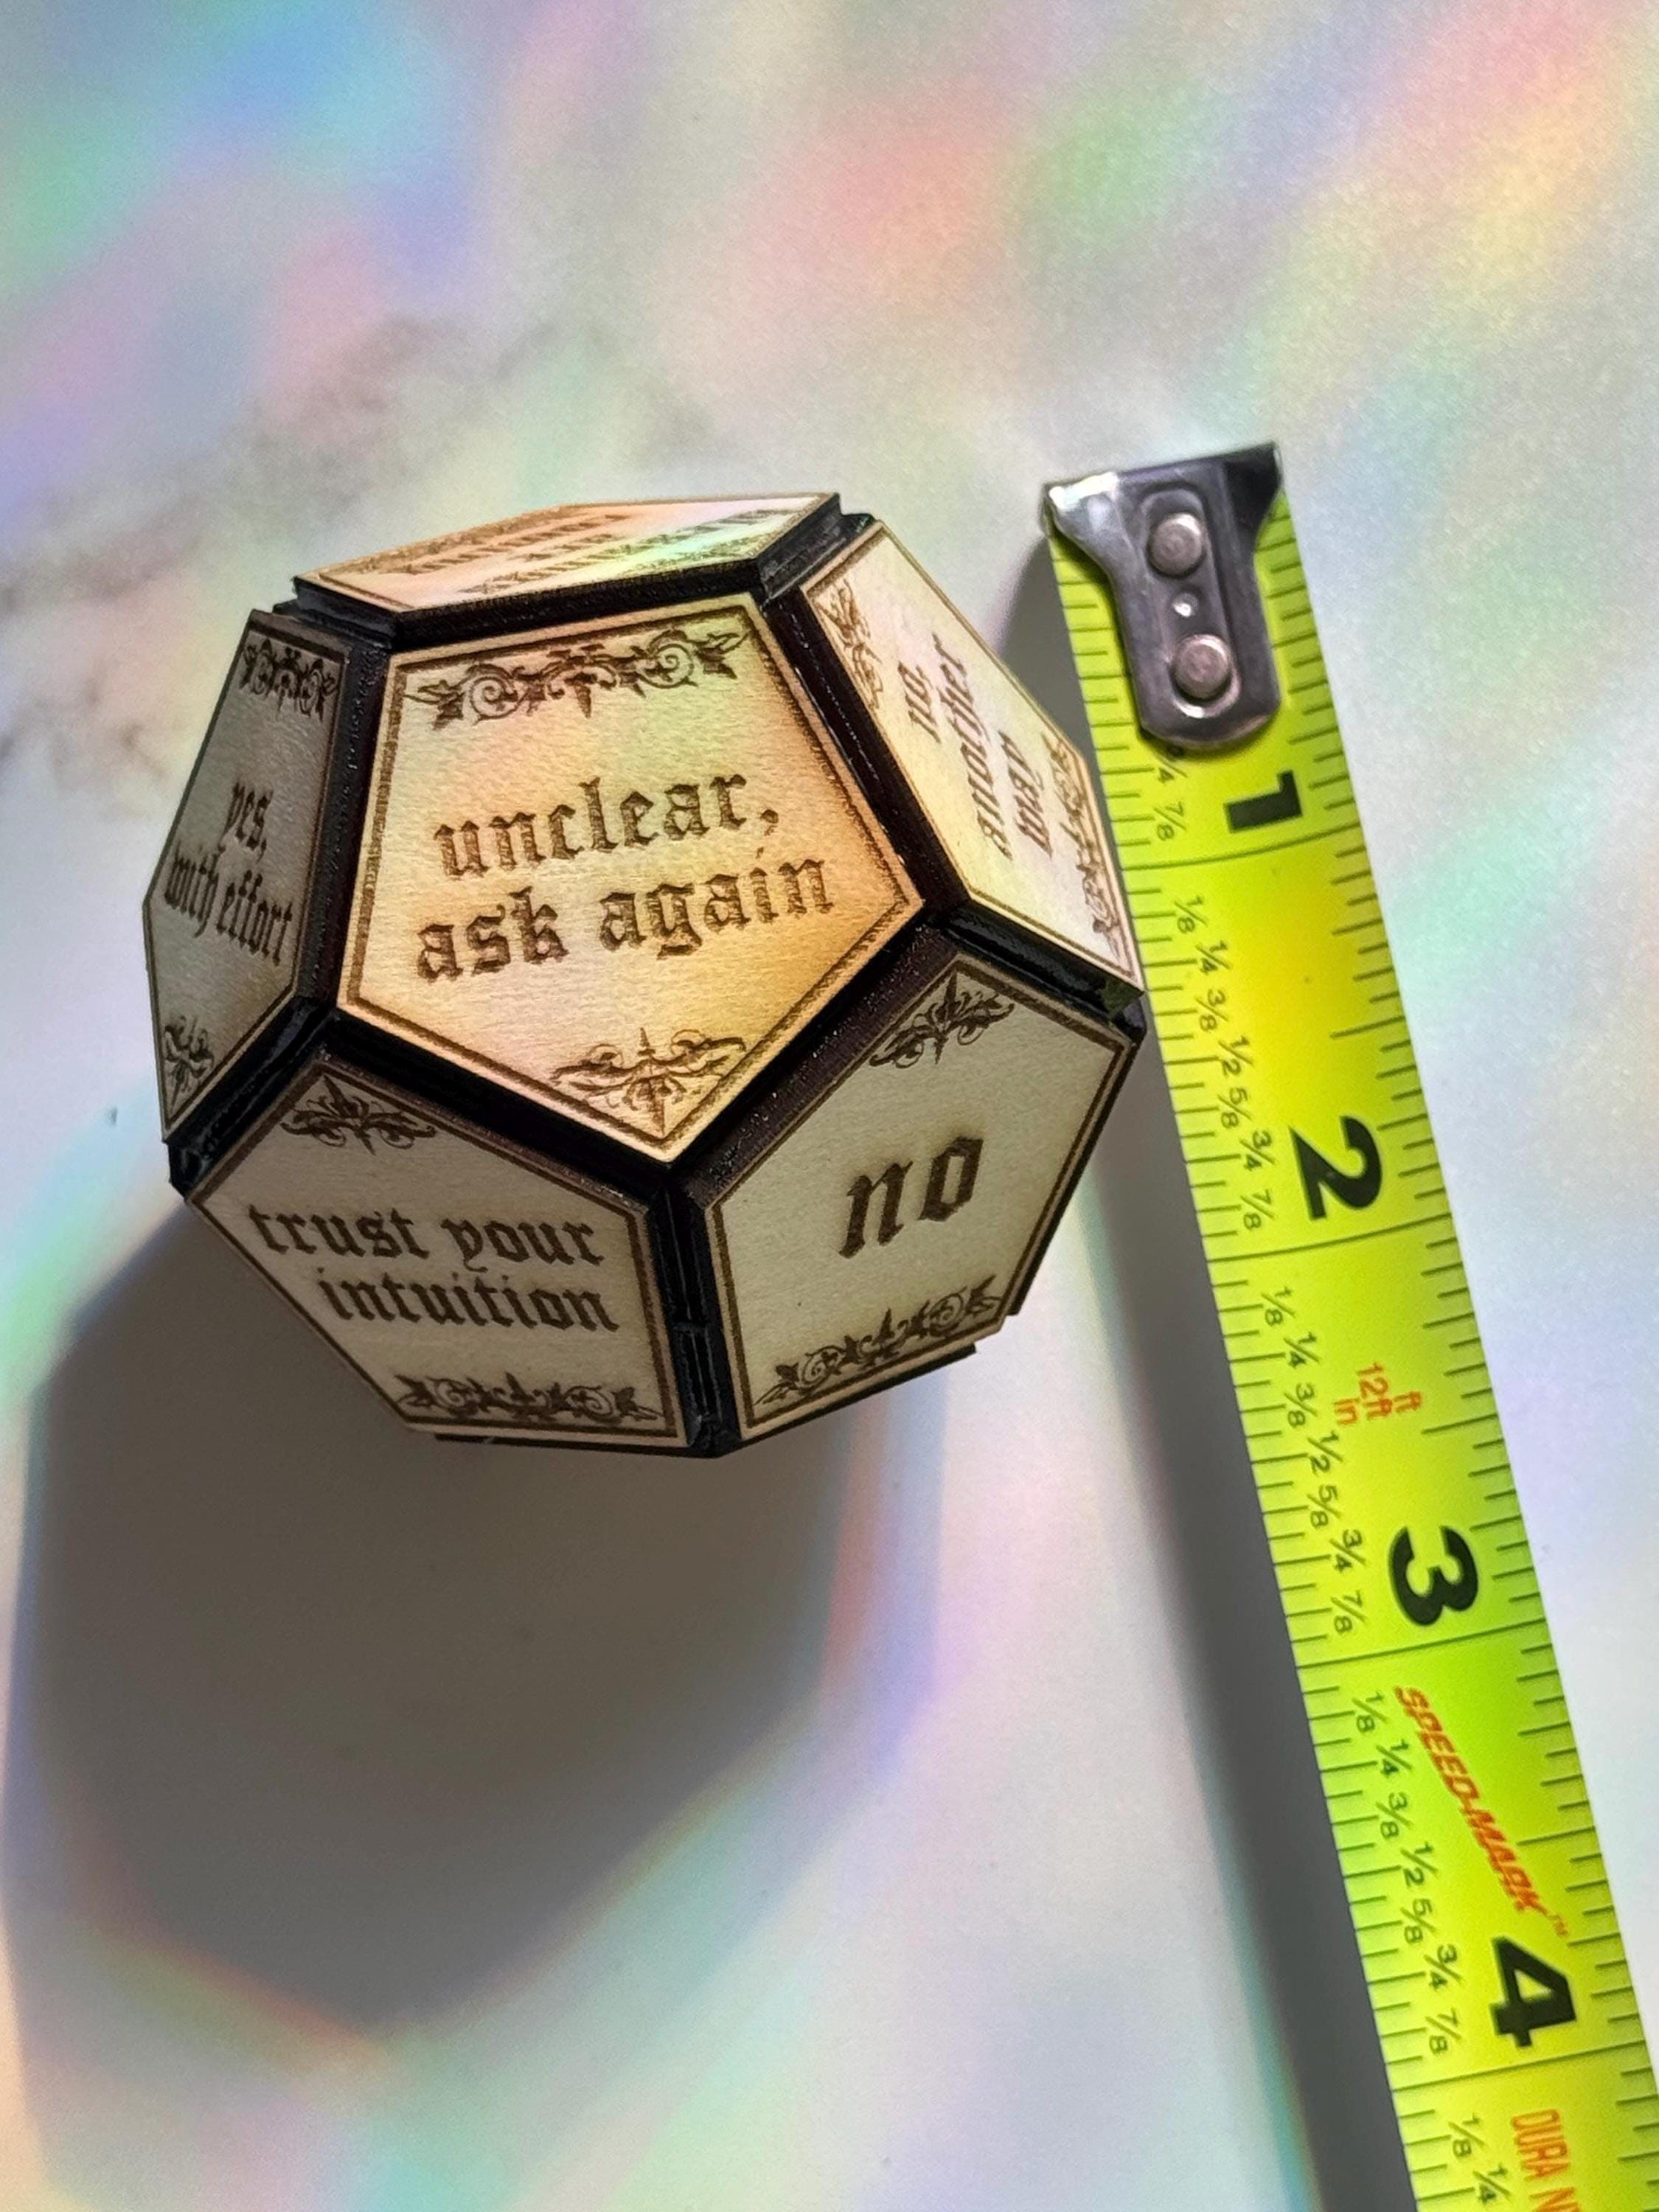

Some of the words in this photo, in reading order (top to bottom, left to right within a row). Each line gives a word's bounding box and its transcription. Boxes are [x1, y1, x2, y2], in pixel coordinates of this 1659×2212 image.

[898, 661, 942, 743] no,
[932, 633, 1013, 861] another
[999, 730, 1054, 859] way
[1223, 770, 1303, 834] 1
[222, 782, 273, 862] yes,
[434, 773, 779, 881] unclear,
[1155, 801, 1188, 843] 7/8
[163, 839, 226, 939] with
[216, 869, 293, 967] effort
[417, 886, 570, 983] ask
[599, 847, 835, 960] again
[1175, 895, 1208, 934] 1/8
[1195, 939, 1231, 976] 1/4
[1196, 990, 1228, 1033] 3/8
[1218, 1034, 1253, 1077] 1/2
[1217, 1088, 1251, 1130] 5/8
[1240, 1130, 1275, 1172] 3/4
[1289, 1116, 1384, 1221] 2
[839, 1136, 984, 1259] no
[1241, 1189, 1275, 1231] 7/8
[248, 1205, 430, 1259] trust
[440, 1219, 605, 1273] your
[317, 1267, 619, 1332] intuition
[1262, 1287, 1295, 1326] 1/8
[1284, 1332, 1320, 1369] 1/4
[1284, 1382, 1318, 1429] 3/8
[1308, 1430, 1344, 1475] 1/2
[1307, 1484, 1341, 1528] 5/8
[1329, 1528, 1366, 1573] 3/4
[1389, 1526, 1479, 1627] 3
[1331, 1590, 1366, 1634] 7/8
[1352, 1691, 1387, 1732] 1/8
[1377, 1739, 1412, 1778] 1/4
[1377, 1793, 1412, 1840] 3/8
[1400, 1842, 1438, 1887] 1/2
[1400, 1899, 1436, 1945] 5/8
[1425, 1944, 1461, 1991] 3/4
[1489, 1937, 1576, 2048] 4
[1426, 2013, 1462, 2056] 7/8
[1448, 2112, 1487, 2159] 1/8
[1512, 2107, 1571, 2183] DURA
[1473, 2164, 1512, 2206] 1/4
